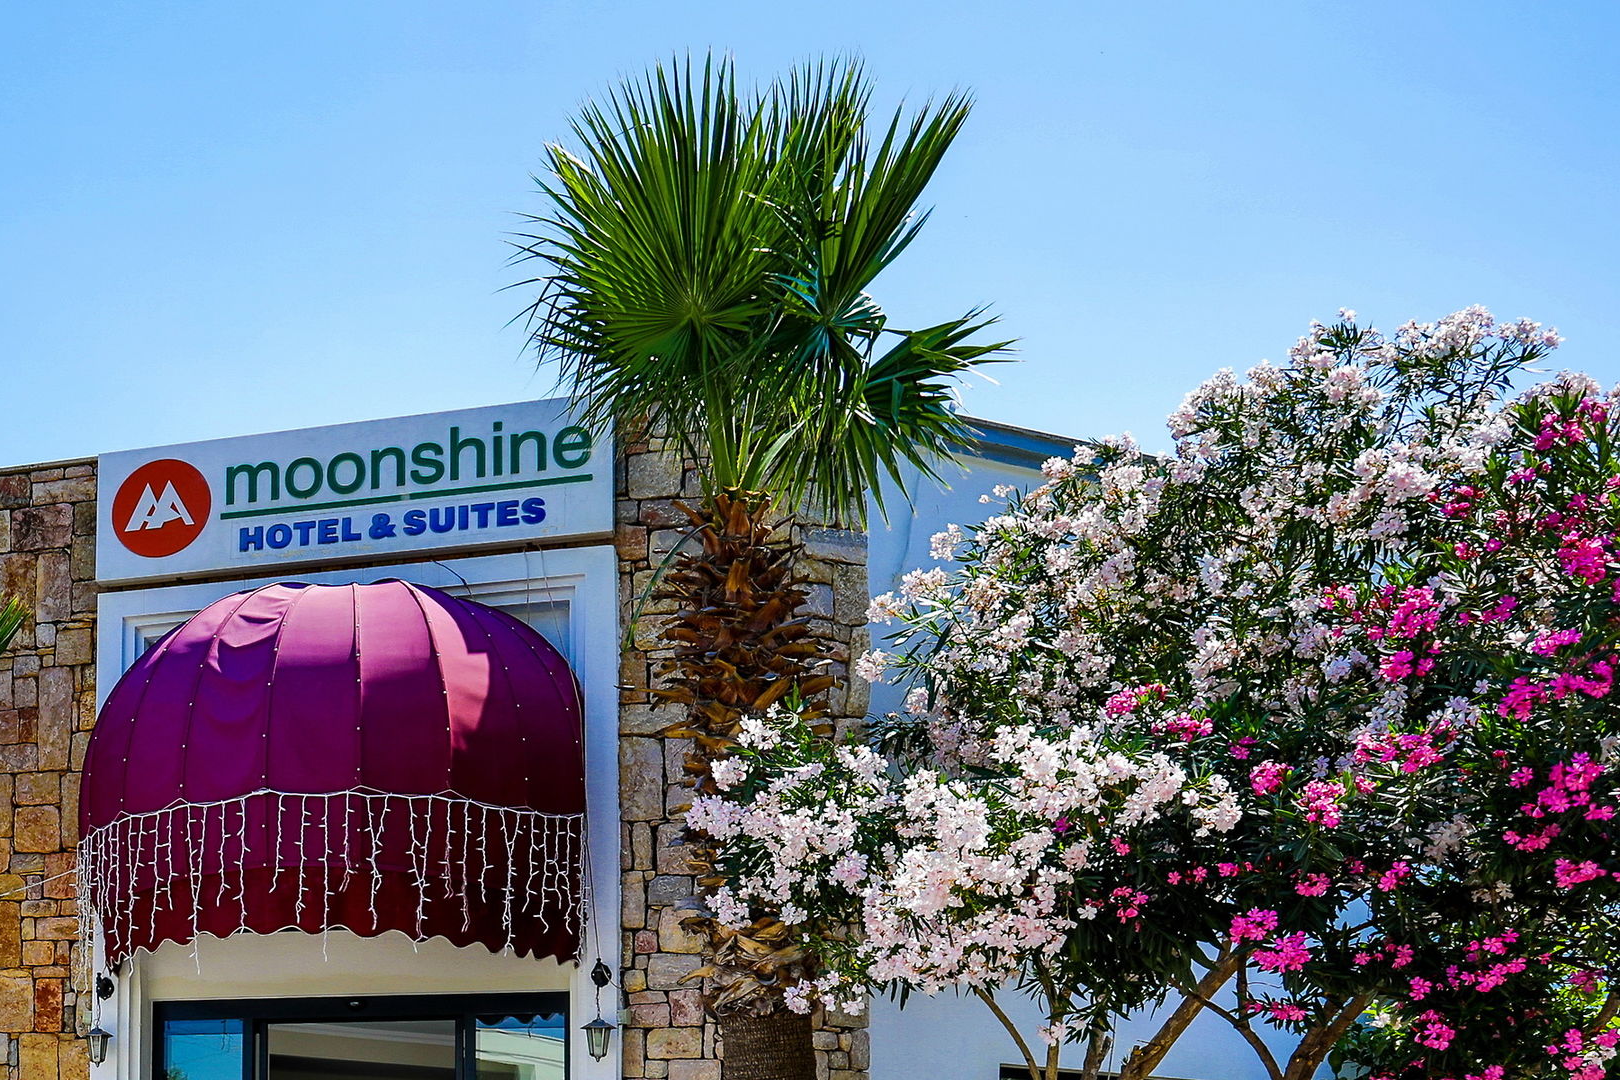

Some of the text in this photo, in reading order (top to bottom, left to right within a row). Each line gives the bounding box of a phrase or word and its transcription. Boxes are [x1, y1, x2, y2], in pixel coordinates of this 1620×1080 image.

[226, 421, 592, 506] moonshine
[239, 497, 547, 553] HOTEL & SUITES
